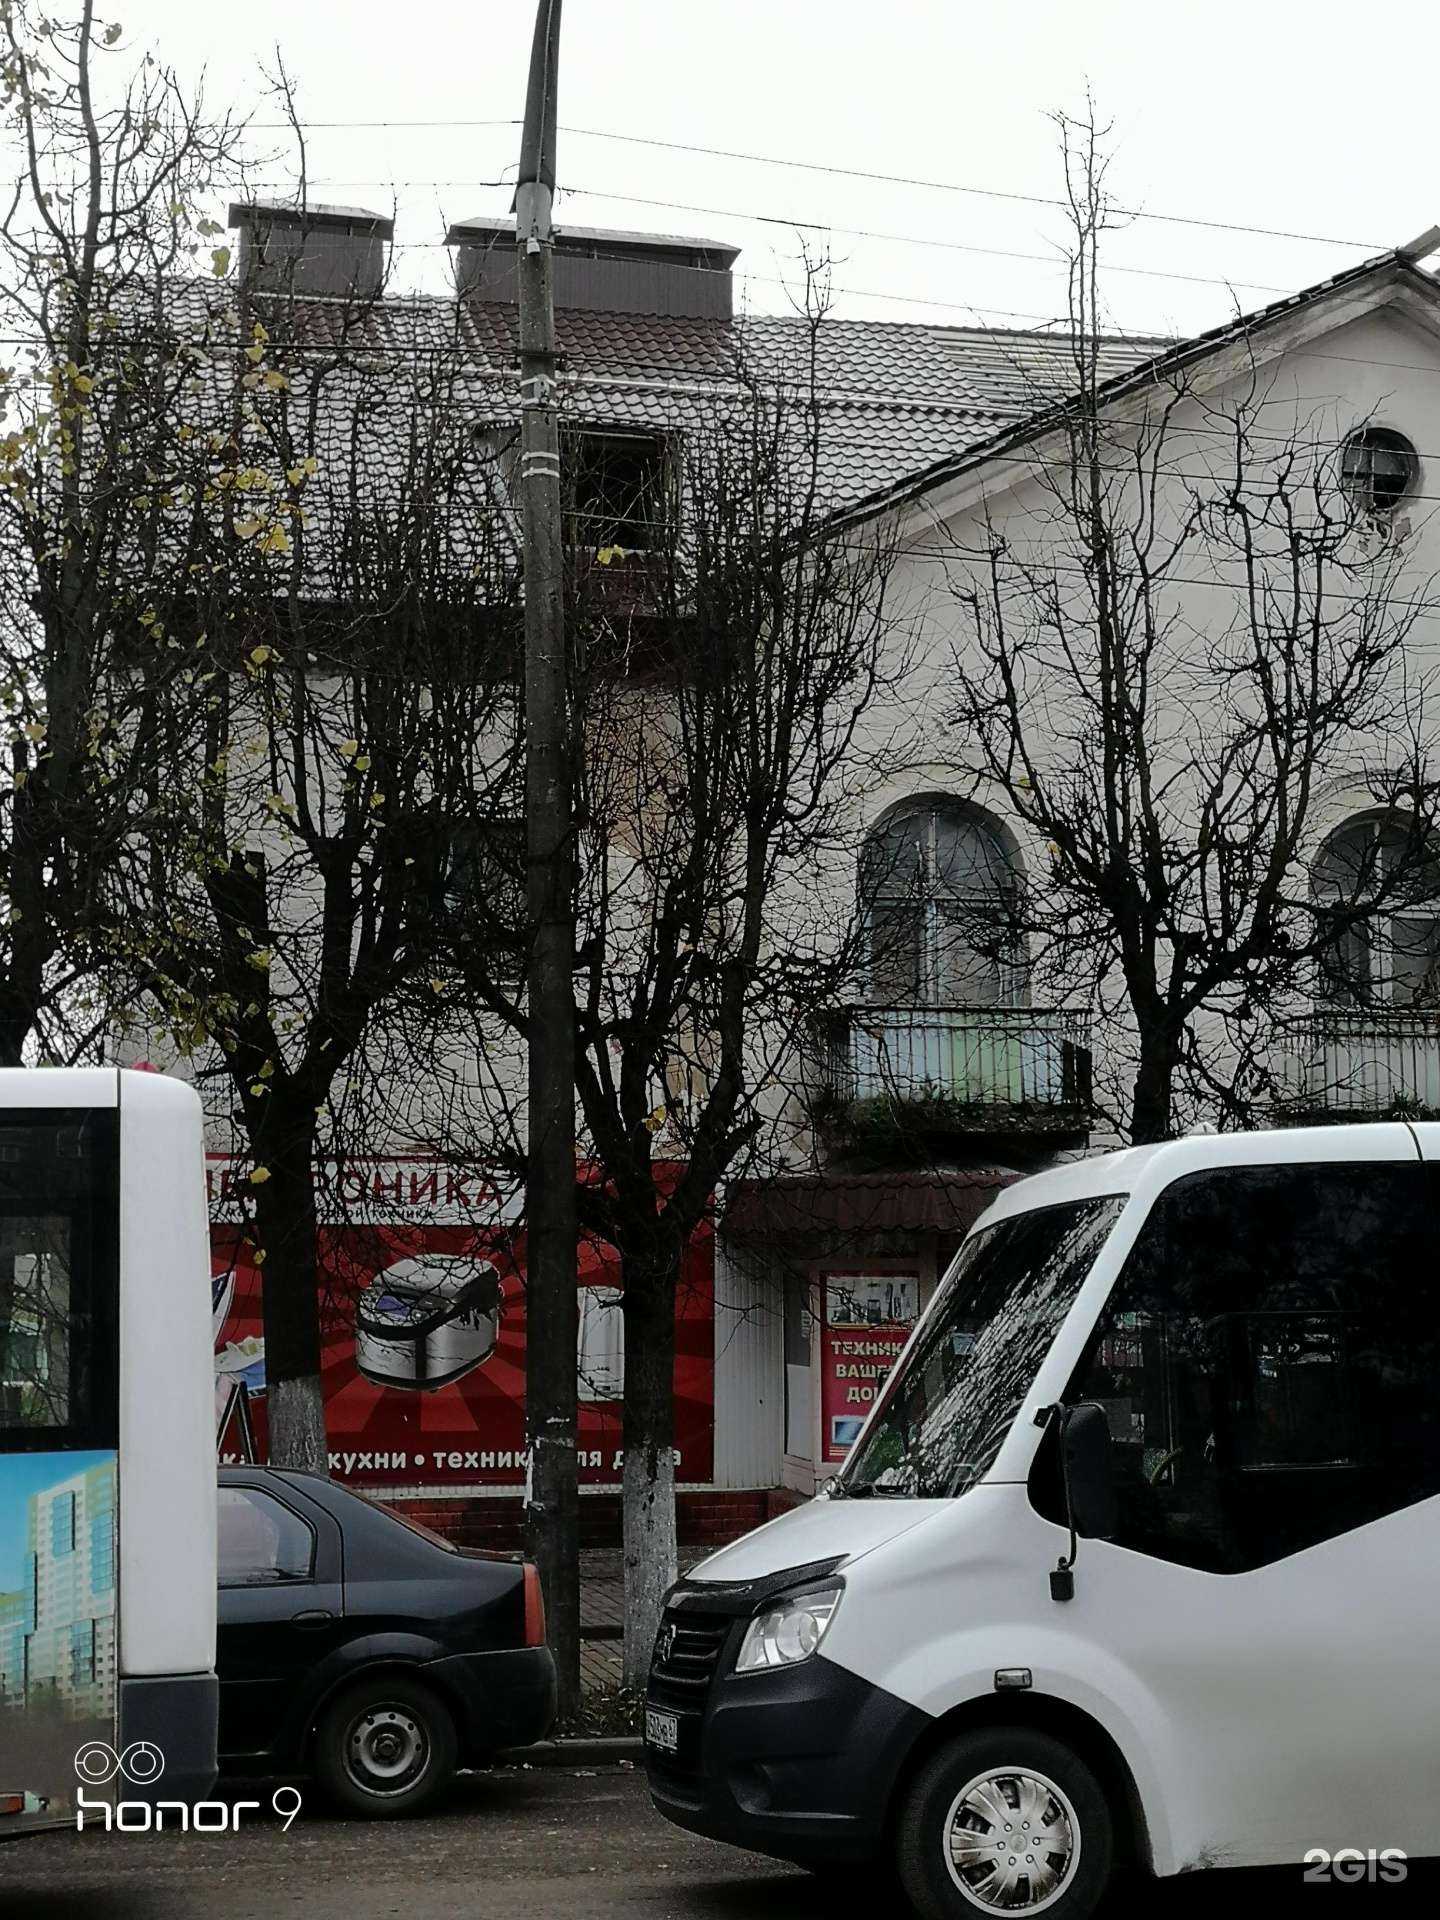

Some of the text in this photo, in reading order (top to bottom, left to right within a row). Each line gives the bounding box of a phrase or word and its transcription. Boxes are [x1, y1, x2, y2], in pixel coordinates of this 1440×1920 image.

[831, 1340, 903, 1356] ТЕХНИК
[328, 1452, 407, 1475] кухни
[433, 1450, 528, 1469] техник
[577, 1451, 602, 1469] ля
